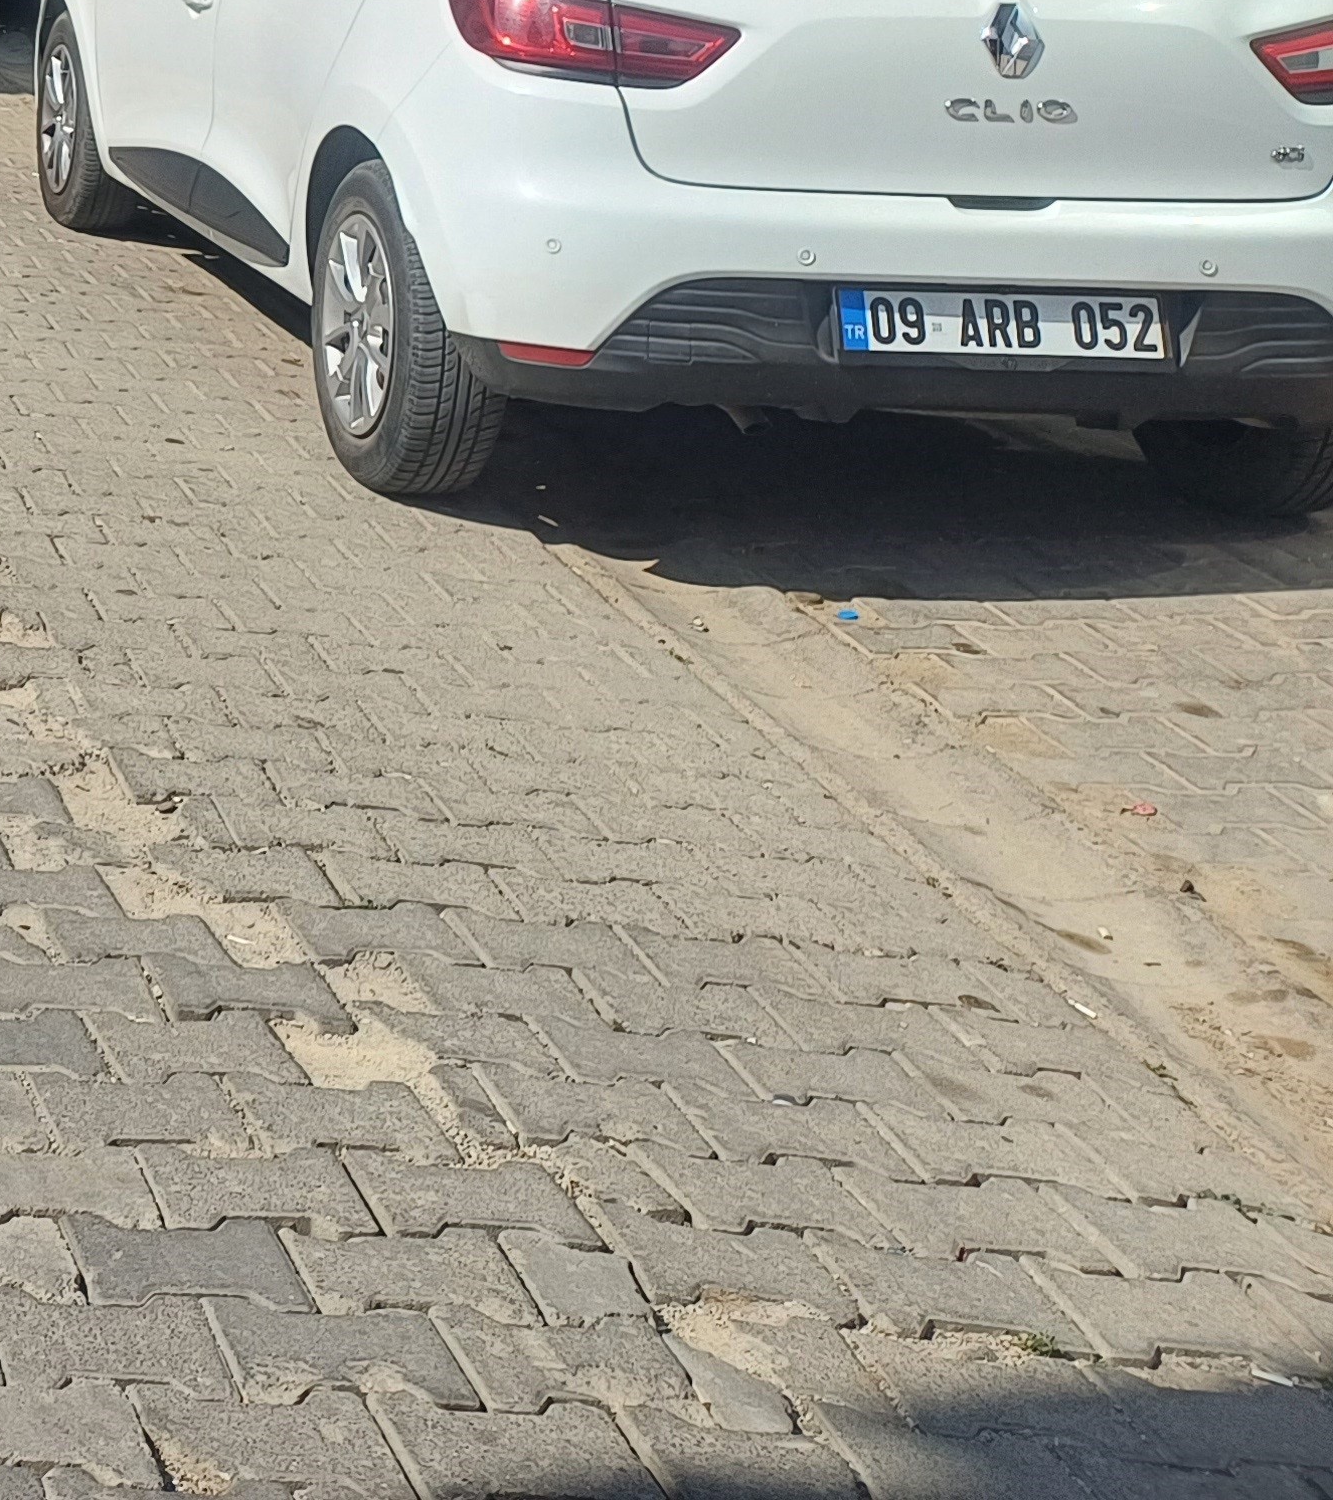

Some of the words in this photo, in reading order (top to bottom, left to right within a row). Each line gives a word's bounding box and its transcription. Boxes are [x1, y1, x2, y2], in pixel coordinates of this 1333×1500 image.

[944, 98, 1074, 123] CLIO
[844, 324, 865, 339] TR
[870, 297, 926, 346] 09
[960, 298, 1041, 348] ARB
[1071, 301, 1158, 353] 052
